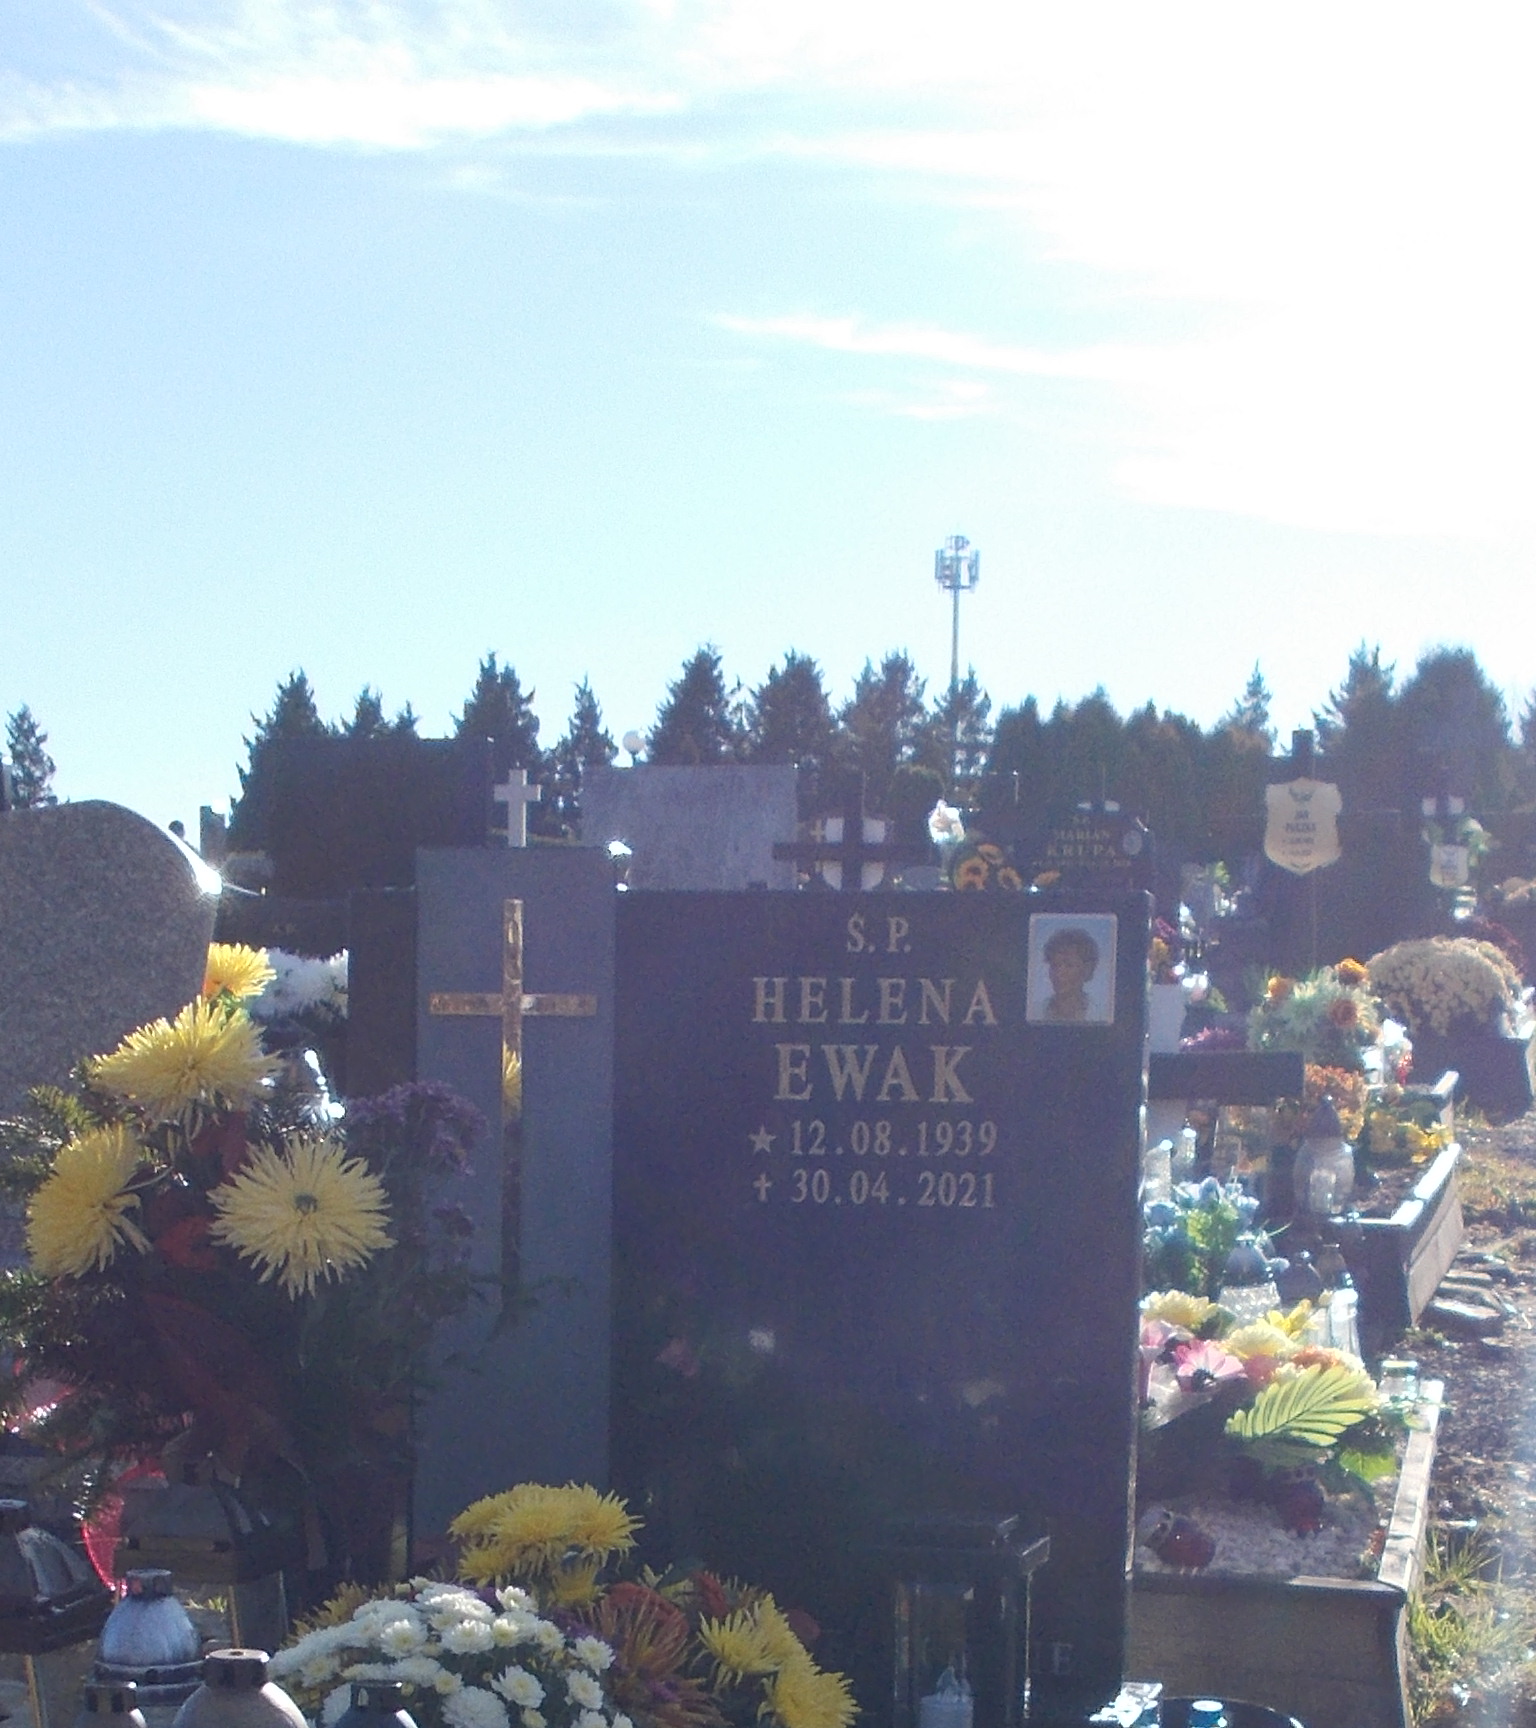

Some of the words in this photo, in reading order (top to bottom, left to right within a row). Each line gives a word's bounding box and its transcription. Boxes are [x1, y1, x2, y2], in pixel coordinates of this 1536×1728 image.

[751, 977, 999, 1026] HELENA
[774, 1043, 974, 1104] EWAK
[790, 1120, 999, 1157] 12.08.1939
[792, 1169, 997, 1208] 30.04.2021
